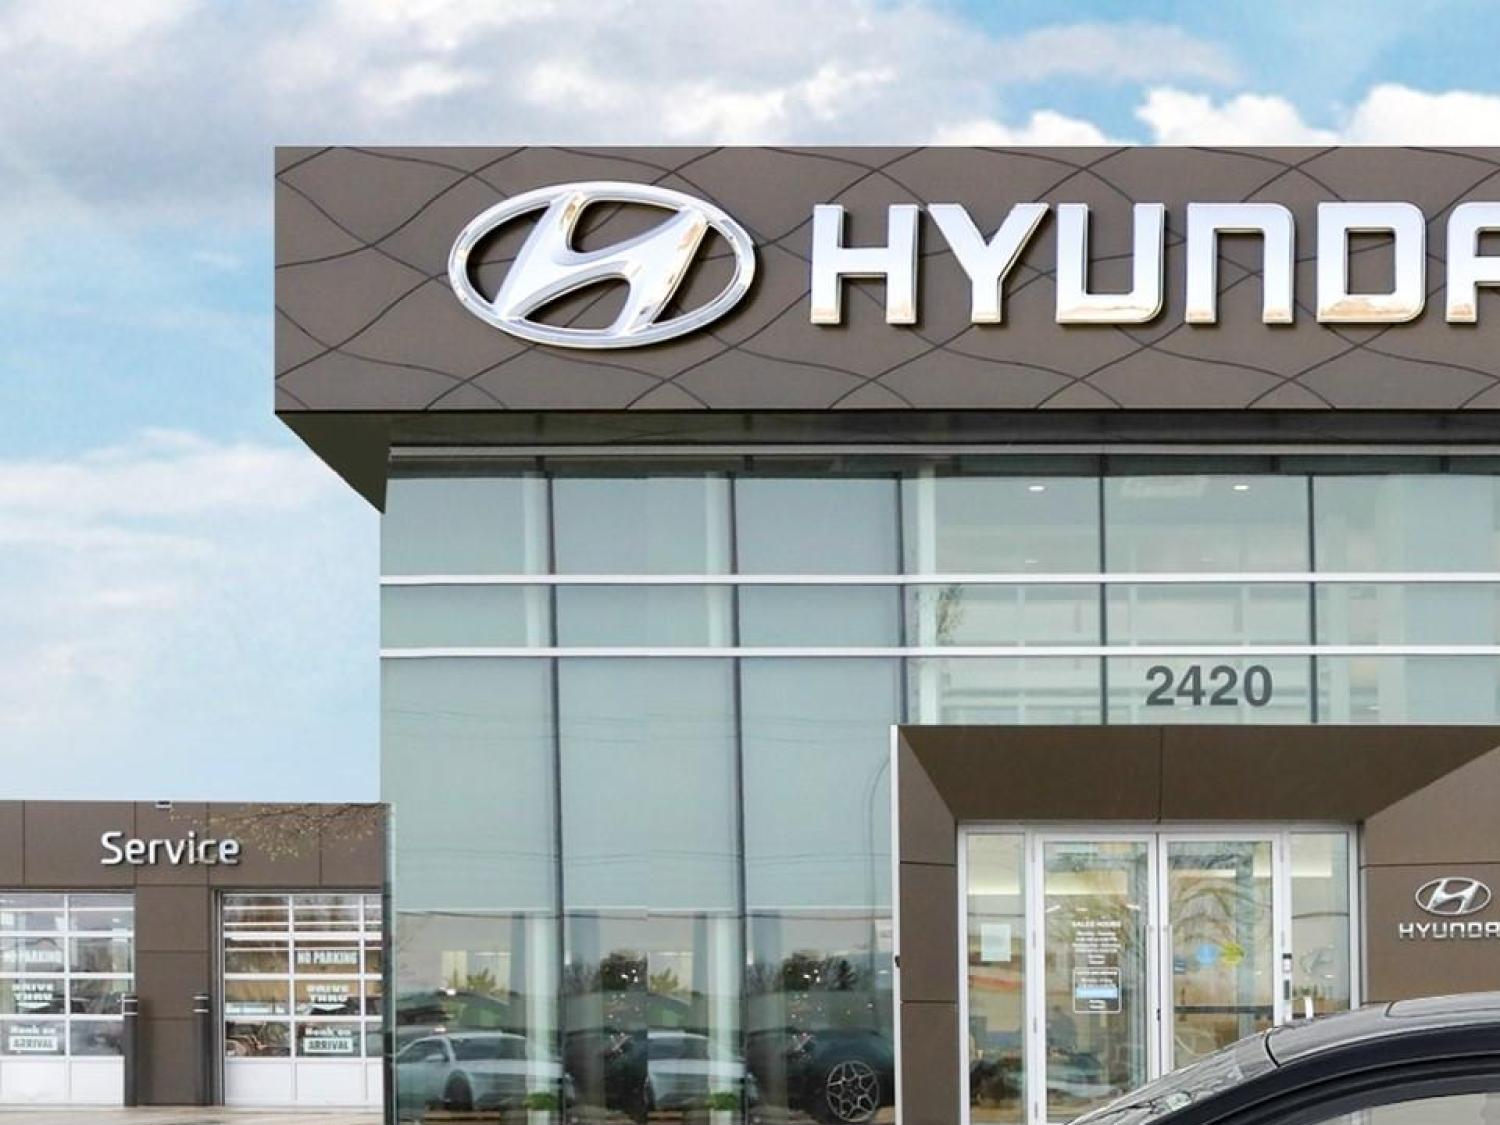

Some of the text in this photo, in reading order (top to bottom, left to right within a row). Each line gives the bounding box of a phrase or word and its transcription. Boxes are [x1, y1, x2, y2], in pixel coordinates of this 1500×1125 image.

[1145, 665, 1273, 706] 2420
[100, 830, 240, 865] Service
[308, 1040, 349, 1051] ARRIVAL
